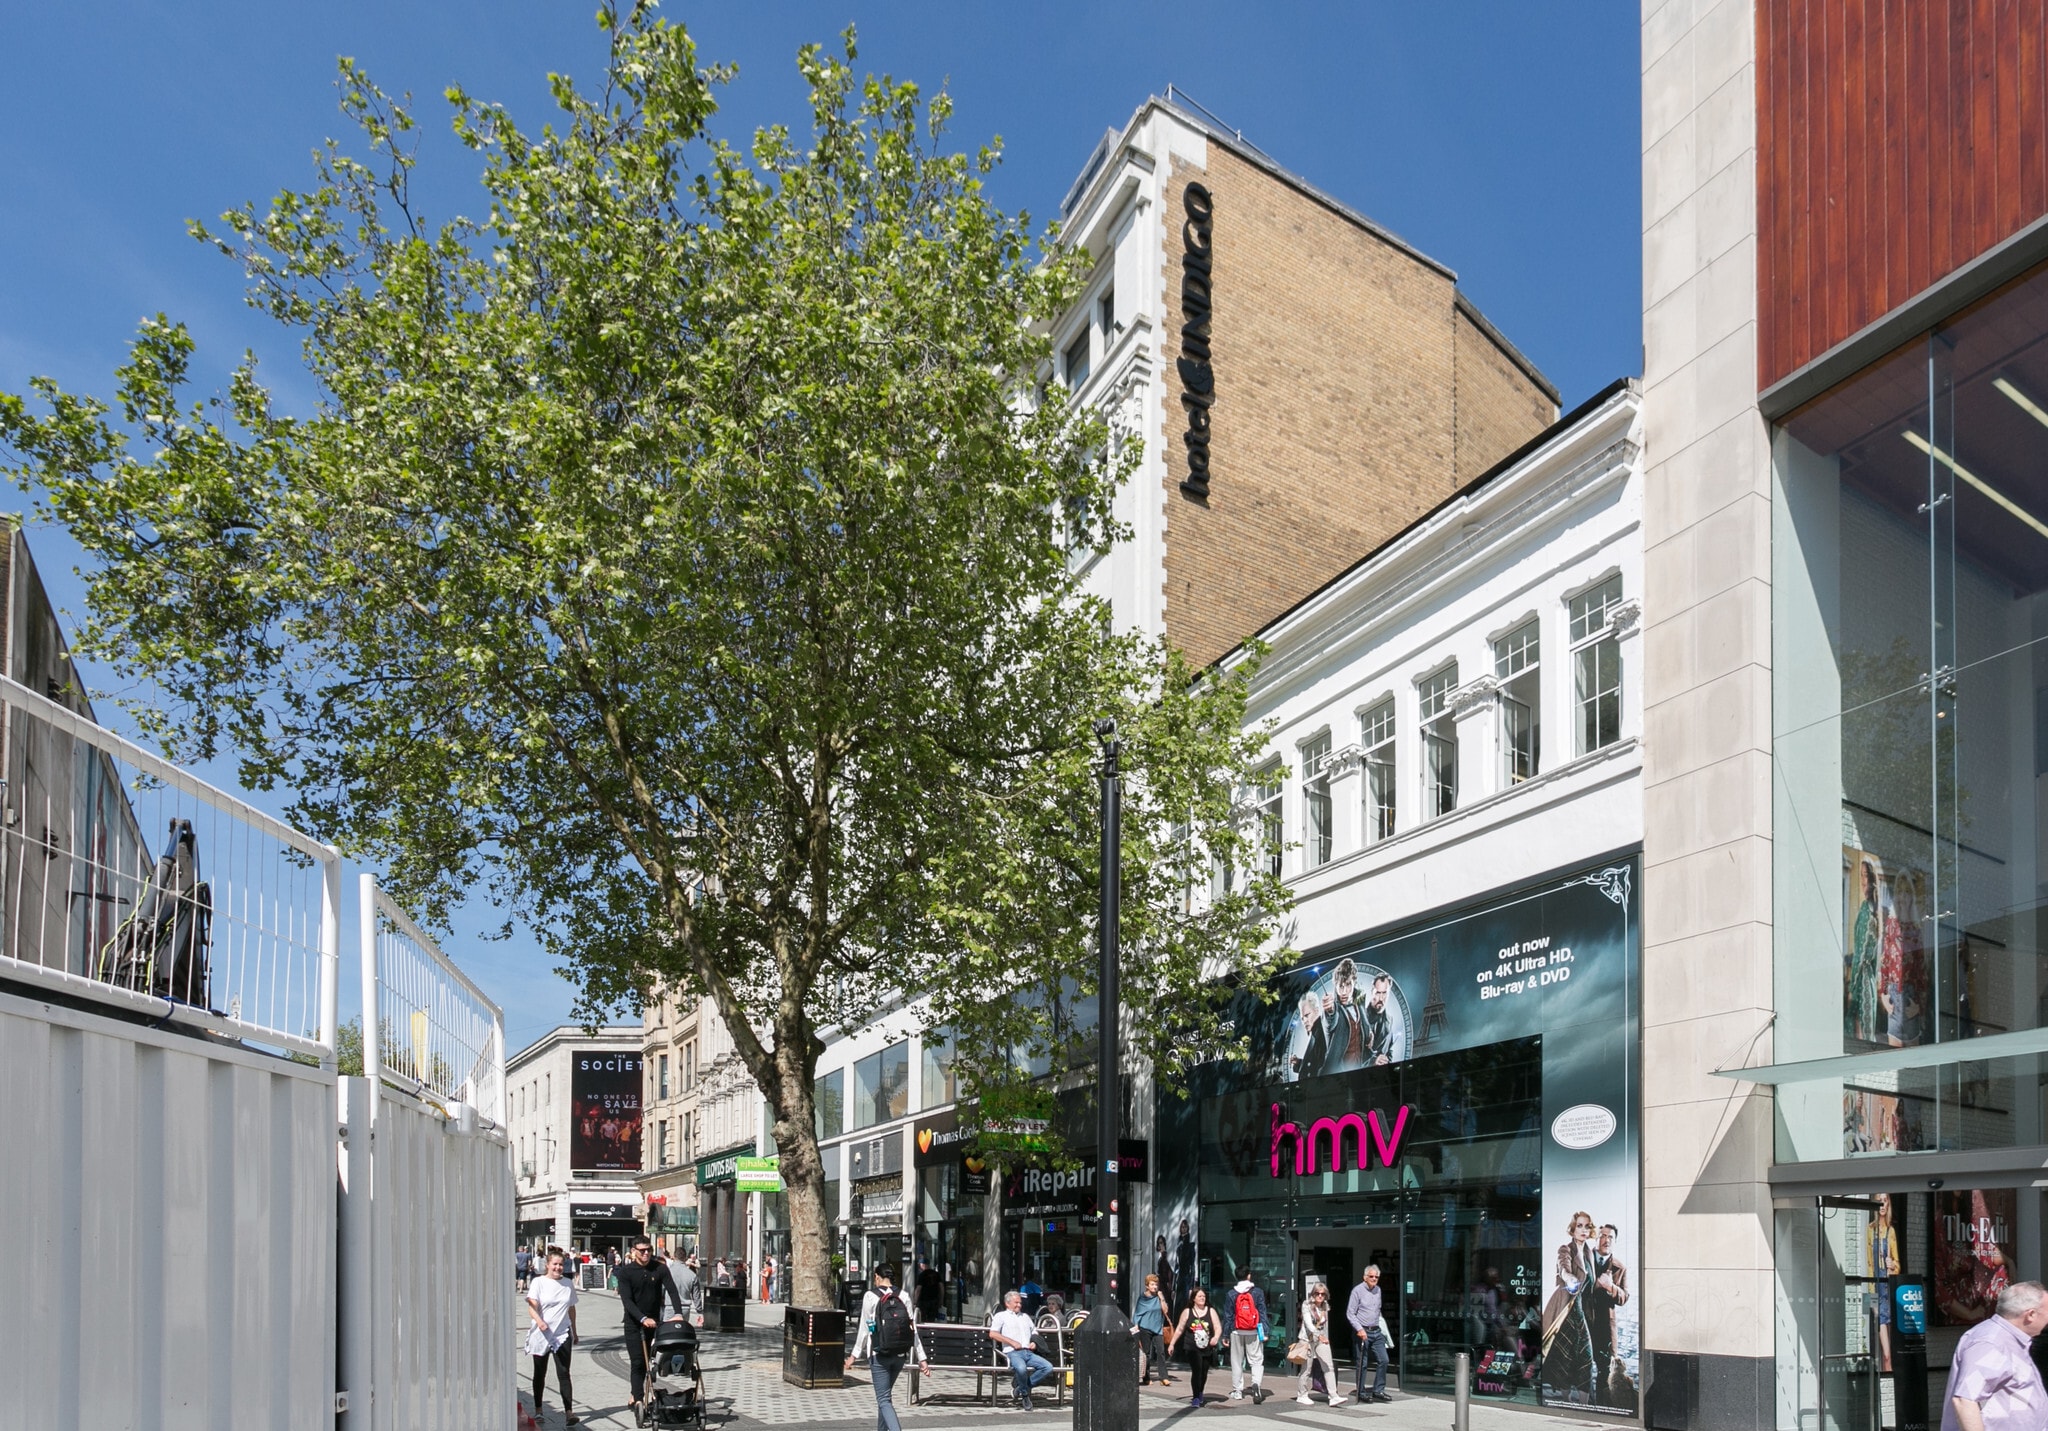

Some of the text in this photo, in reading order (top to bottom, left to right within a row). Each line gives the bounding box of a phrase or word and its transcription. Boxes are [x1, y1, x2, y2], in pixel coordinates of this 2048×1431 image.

[1180, 181, 1213, 500] hotel INDIGO
[1498, 936, 1550, 959] out now
[1477, 947, 1575, 983] on 4K Ultra HD,
[1480, 966, 1570, 1000] Blu-ray & DVD
[581, 1059, 643, 1072] SOCIET
[604, 1100, 638, 1109] SAVE
[932, 1130, 959, 1146] Thomas
[1271, 1102, 1415, 1178] hmv
[705, 1156, 738, 1179] LLOYDS BAN
[1117, 1154, 1144, 1167] hmv
[1024, 1166, 1096, 1196] iRepair
[575, 1207, 613, 1216] Superdrug
[1943, 1213, 2009, 1244] The Edit
[1516, 1265, 1537, 1277] 2 for
[1478, 1378, 1504, 1393] hmv
